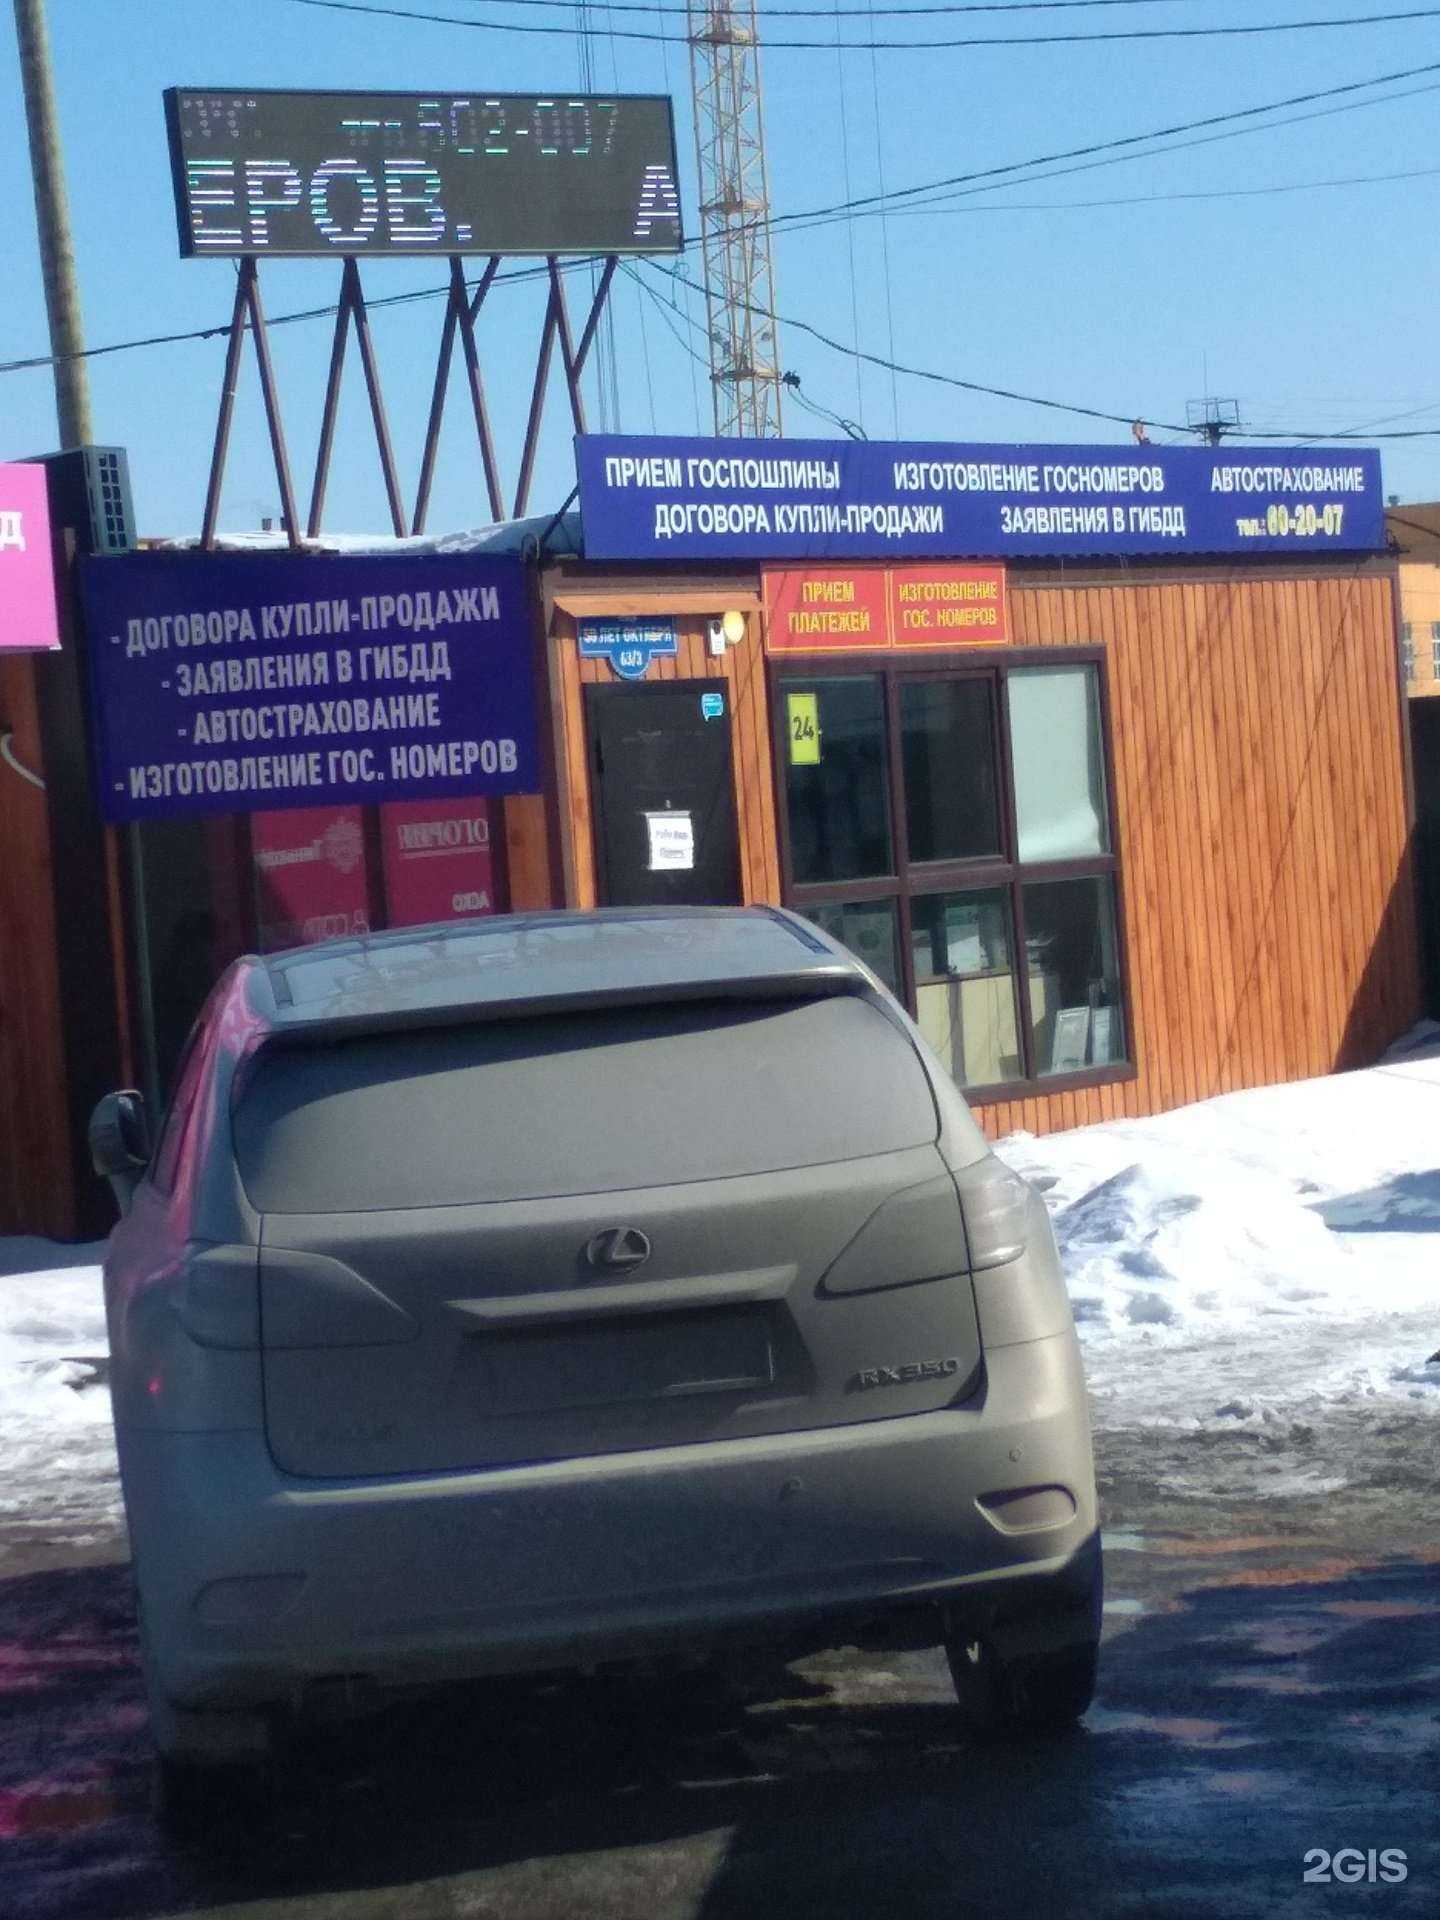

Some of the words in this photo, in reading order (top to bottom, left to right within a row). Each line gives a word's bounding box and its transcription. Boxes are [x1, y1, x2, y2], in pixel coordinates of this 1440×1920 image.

[605, 457, 681, 488] ПРИЕМ
[687, 458, 840, 490] ГОСПОШЛИНЫ
[894, 462, 1039, 493] ИЗГОТОВЛЕНИЕ
[1044, 465, 1165, 493] ГОСНОМЕРОВ
[1211, 466, 1364, 493] АВТОСТРАХОВАНИЕ
[655, 503, 770, 538] ДОГОВОРА
[774, 504, 944, 539] КУПЛИ-ПРОДАЖИ
[1001, 506, 1108, 534] ЗАЯВЛЕНИЯ
[1113, 506, 1125, 533] В
[1129, 506, 1186, 538] ГИБДД
[802, 581, 855, 602] ПРИЕМ
[899, 581, 998, 602] ИЗГОТОВЛЕНИЕ
[126, 609, 257, 658] ДОГОВОРА
[261, 586, 501, 641] КУПЛИ-ПРОДАЖИ
[788, 607, 871, 633] ПЛАТЕЖЕЙ
[903, 609, 933, 629] ГОС.
[937, 607, 997, 627] НОМЕРОВ
[176, 651, 330, 697] ЗАЯВЛЕНИЯ
[336, 649, 352, 682] В
[359, 640, 452, 682] ГИБДД
[193, 692, 442, 745] АВТОСТРАХОВАНИЕ
[129, 752, 323, 800] ИЗГОТОВЛЕНИЕ
[328, 747, 385, 784] ГОС.
[390, 738, 519, 781] НОМЕРОВ
